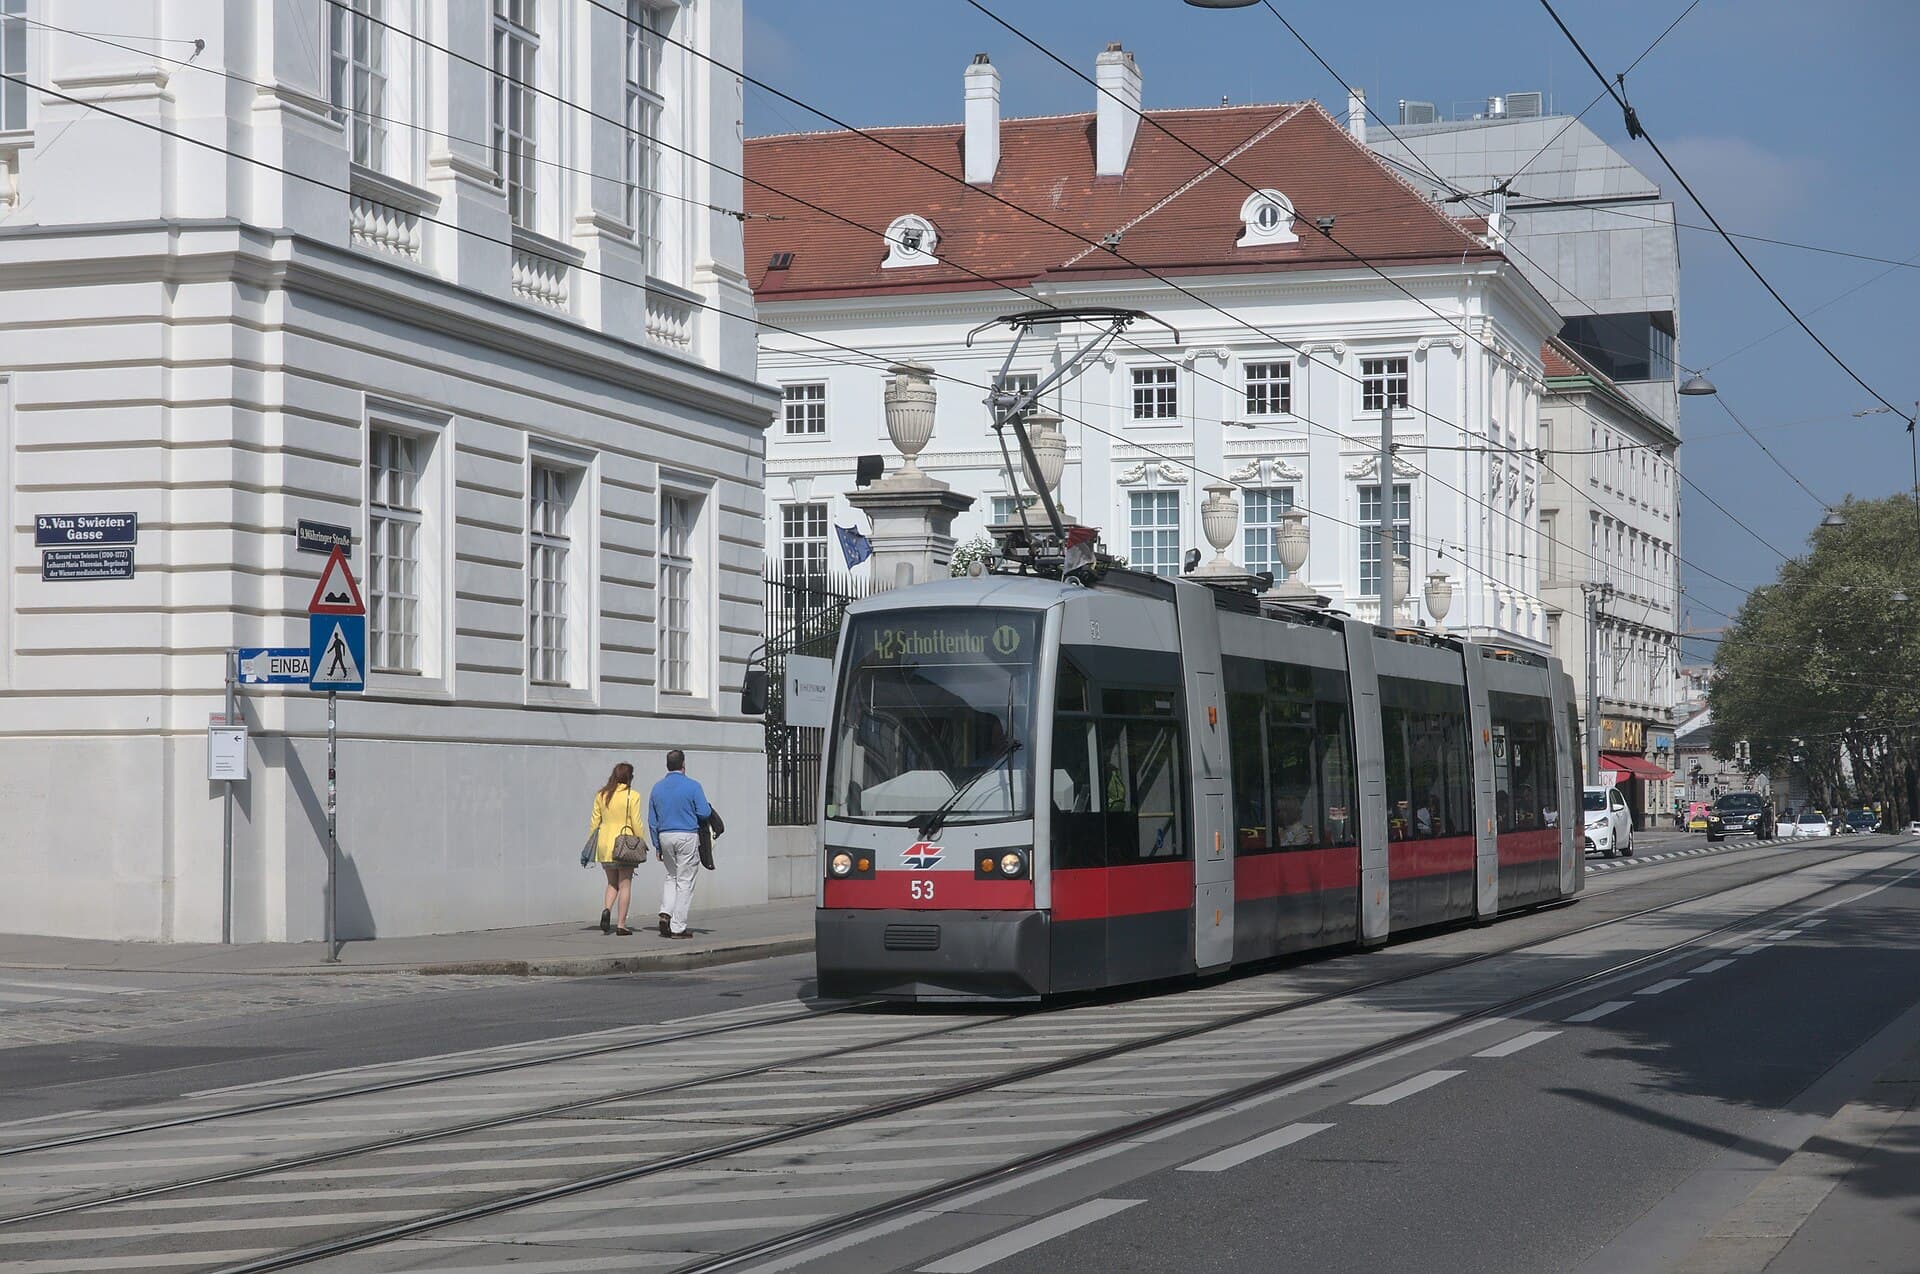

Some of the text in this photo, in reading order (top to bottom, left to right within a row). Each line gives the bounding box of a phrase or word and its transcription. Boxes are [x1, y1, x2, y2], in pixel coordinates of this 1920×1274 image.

[52, 517, 75, 529] Van
[67, 529, 103, 540] Gasse
[874, 629, 894, 659] 42
[896, 629, 987, 655] Schottentor
[270, 659, 309, 673] EINBA
[911, 880, 934, 900] 53
